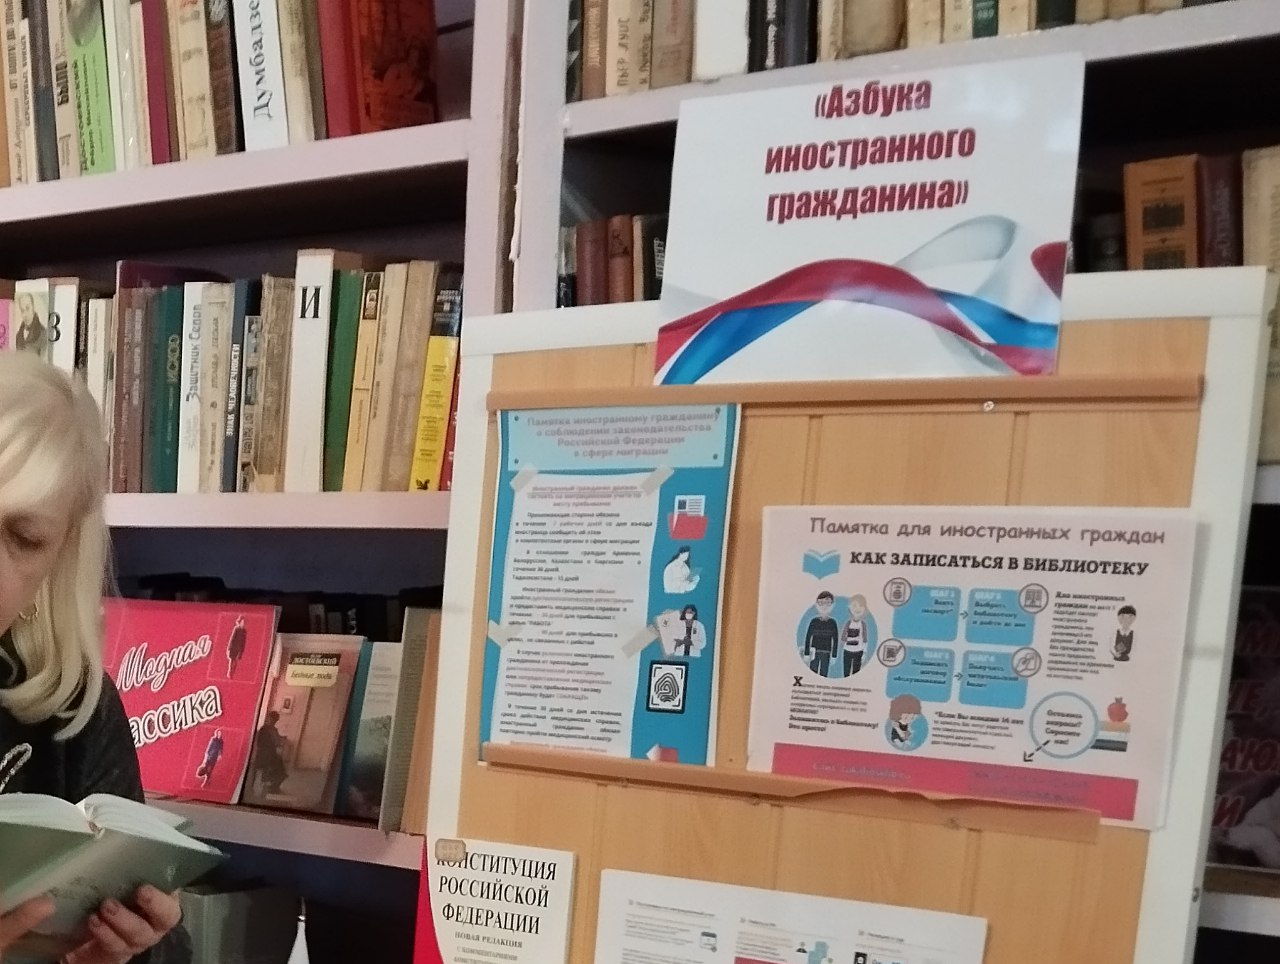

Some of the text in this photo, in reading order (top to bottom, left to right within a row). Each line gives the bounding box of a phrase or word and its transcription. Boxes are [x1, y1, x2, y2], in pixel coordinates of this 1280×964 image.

[55, 61, 70, 106] БЫЛО
[814, 79, 932, 120] «Азбука
[764, 127, 976, 175] иностранного
[766, 179, 969, 225] гражданина»
[299, 285, 322, 318] И
[48, 311, 61, 342] З
[527, 416, 570, 427] Памятка
[809, 517, 1166, 546] Памятка для иностранных граждан
[850, 551, 1150, 576] КАК ЗАПИСАТЬСЯ В БИБЛИОТЕКУ
[116, 635, 212, 691] Модная
[438, 875, 550, 908] РОССИЙСКОЙ
[442, 902, 541, 935] ФЕДЕРАЦИИ
[455, 931, 522, 948] НОВАЯ РЕДАКЦИЯ
